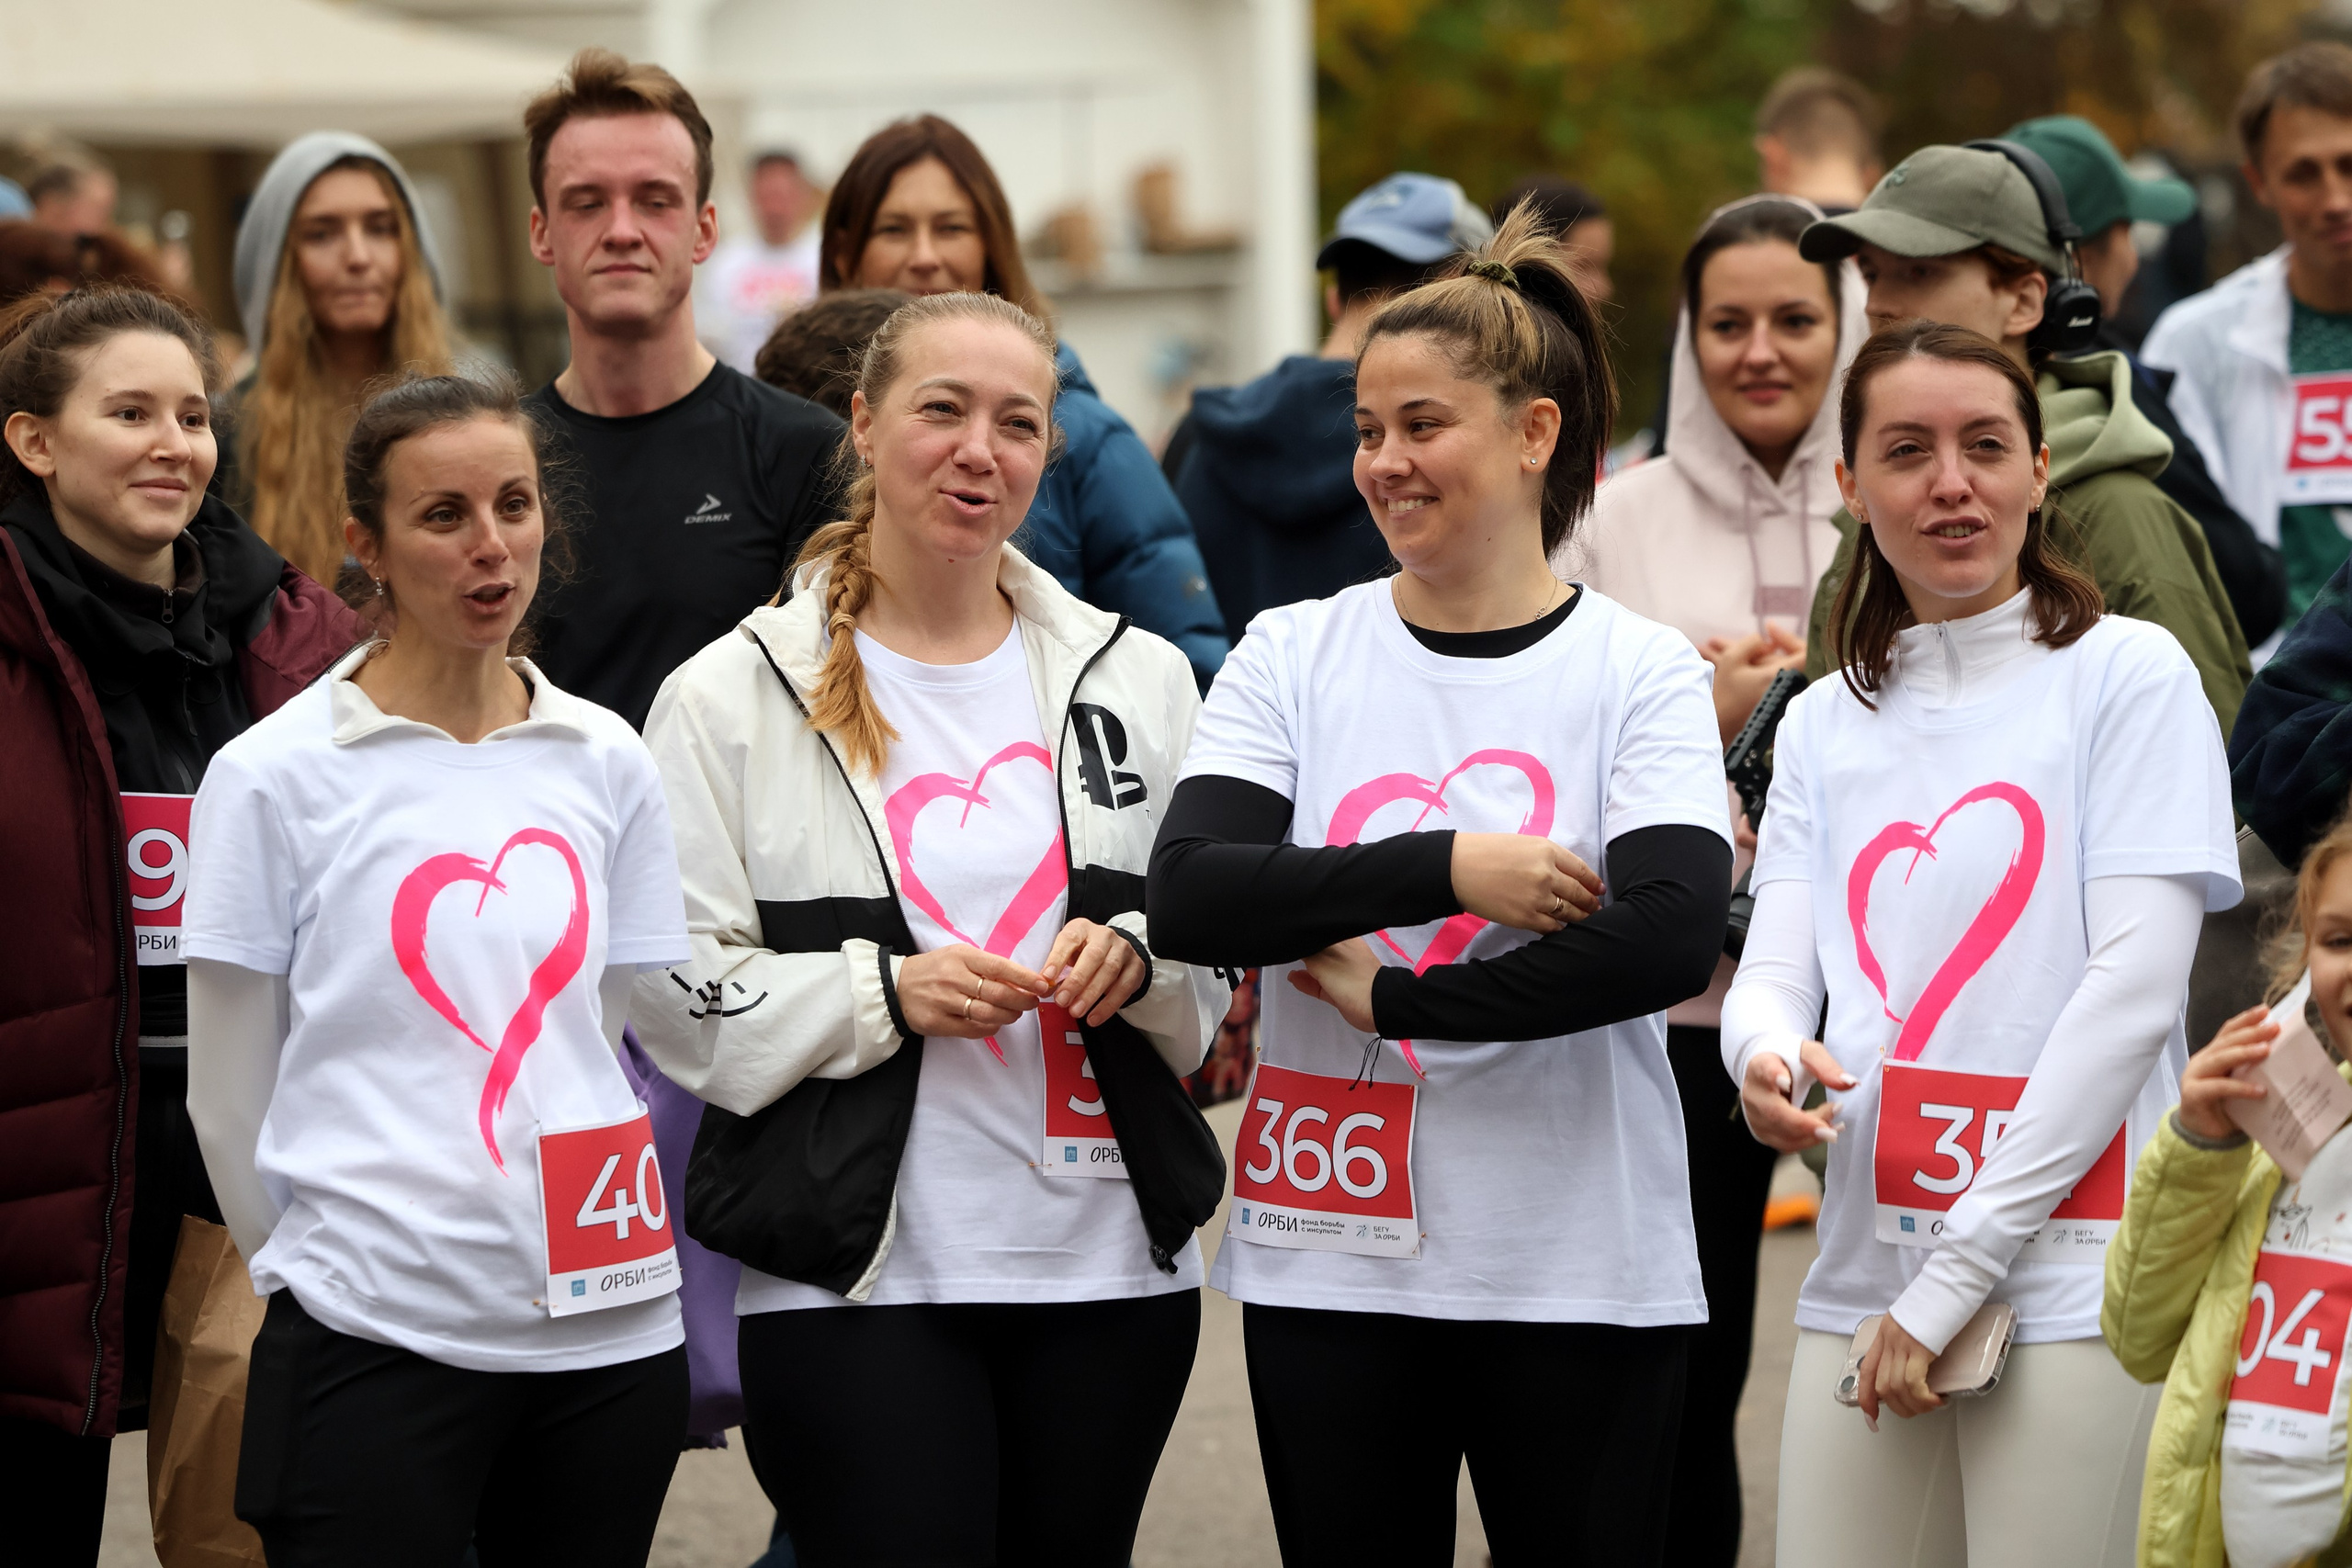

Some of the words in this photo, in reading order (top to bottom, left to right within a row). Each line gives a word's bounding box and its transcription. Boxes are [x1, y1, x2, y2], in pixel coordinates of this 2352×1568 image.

[2296, 396, 2352, 463] 5
[684, 513, 732, 525] DEMIX
[136, 933, 176, 951] РБИ
[1243, 1096, 1389, 1200] 366
[575, 1141, 667, 1241] 40
[1258, 1212, 1298, 1233] ОРБИ
[1300, 1218, 1319, 1227] фонд
[1319, 1219, 1345, 1229] борьбы
[1306, 1227, 1342, 1235] инсультом
[2074, 1229, 2095, 1237] БЕГУ
[600, 1267, 646, 1292] ОРБИ
